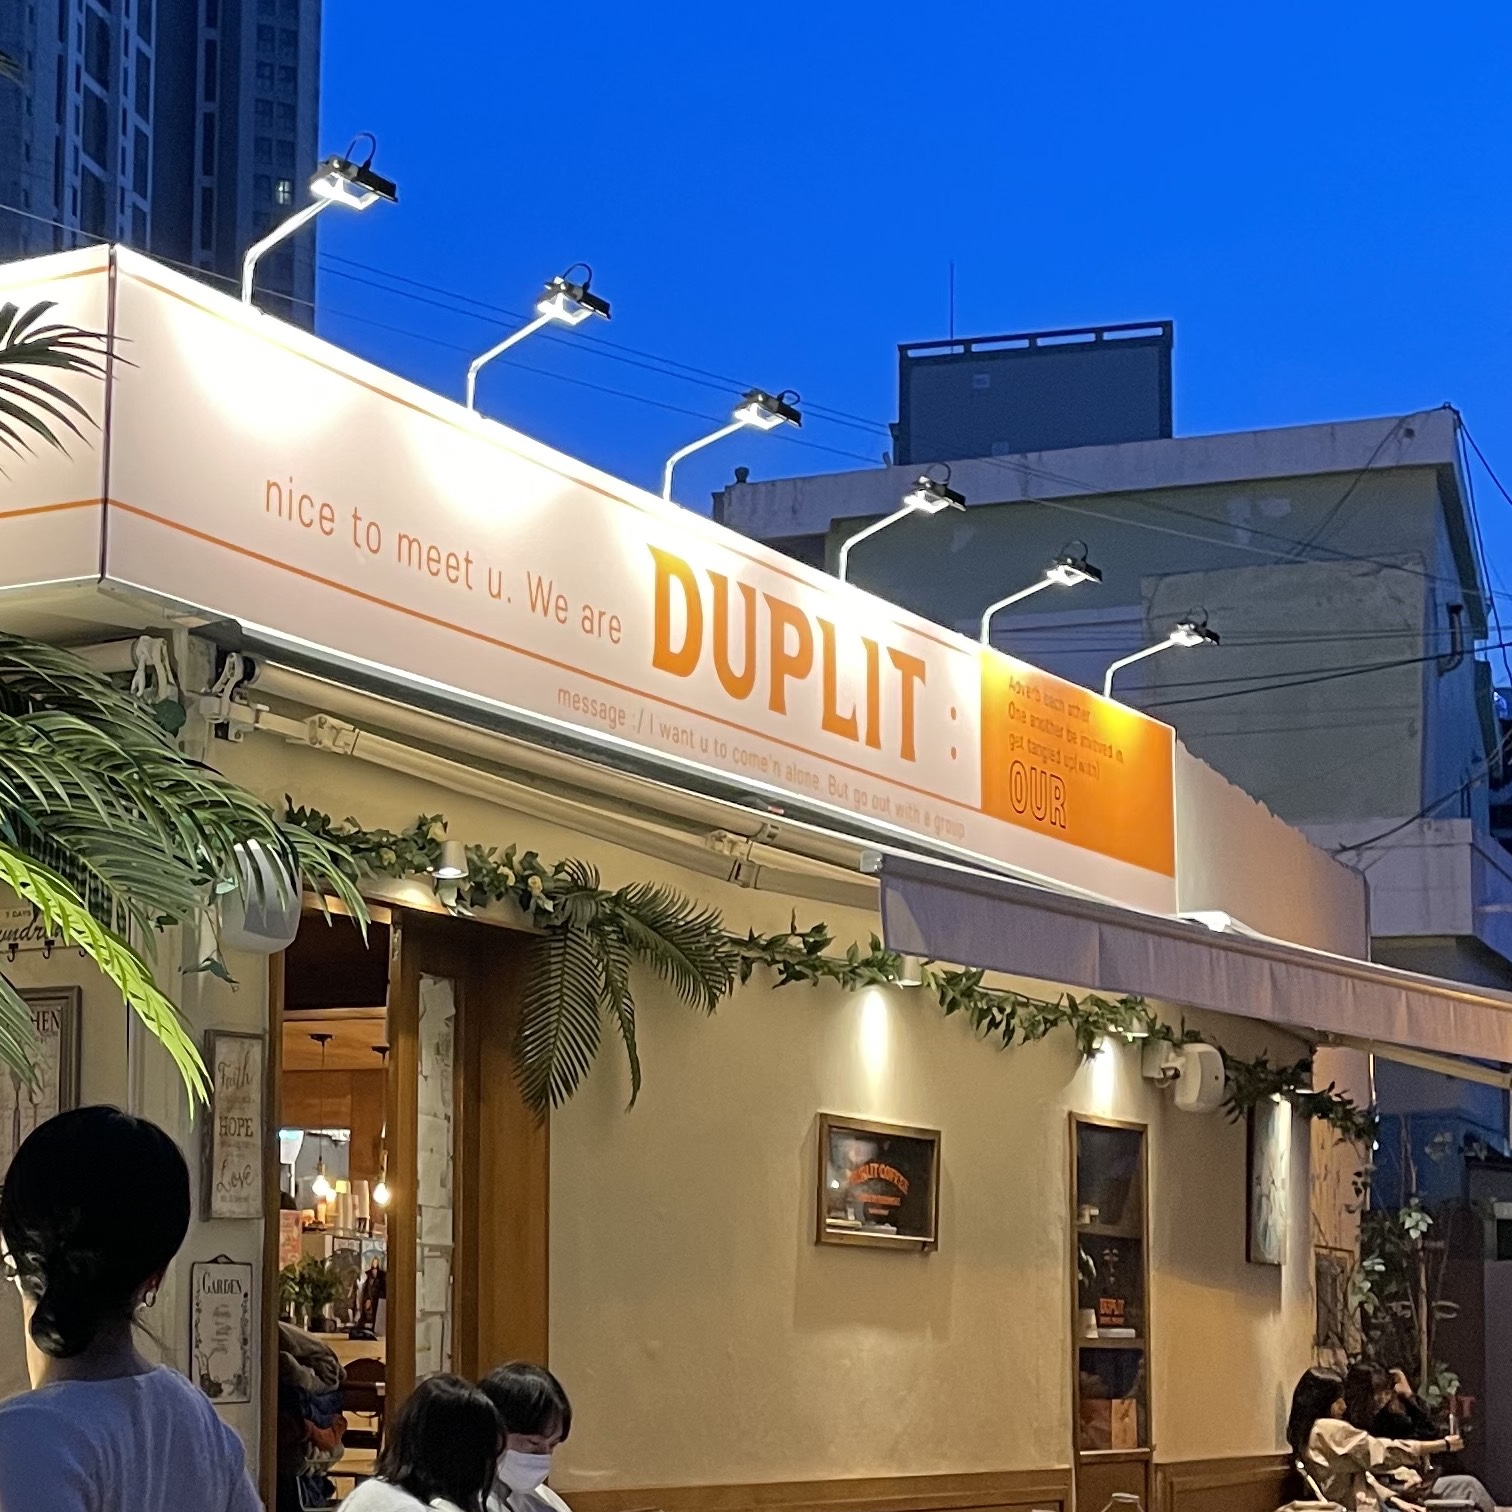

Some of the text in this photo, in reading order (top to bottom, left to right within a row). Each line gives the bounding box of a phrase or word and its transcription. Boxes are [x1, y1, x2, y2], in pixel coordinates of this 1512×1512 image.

[265, 475, 335, 536] nice
[351, 507, 382, 554] to
[397, 532, 473, 590] meet
[487, 567, 512, 603] u.
[527, 570, 569, 624] We
[581, 604, 622, 644] are
[646, 542, 926, 762] DUPLIT
[1008, 701, 1026, 724] One
[557, 687, 626, 730] message
[659, 721, 695, 749] want
[700, 736, 709, 753] u
[714, 737, 728, 759] to
[828, 774, 849, 801] But
[853, 787, 868, 809] go
[872, 793, 890, 812] out
[895, 800, 920, 822] with
[1009, 760, 1067, 829] OUR
[218, 1051, 255, 1090] Faith
[218, 1116, 254, 1138] HOPE
[216, 1158, 256, 1194] Love
